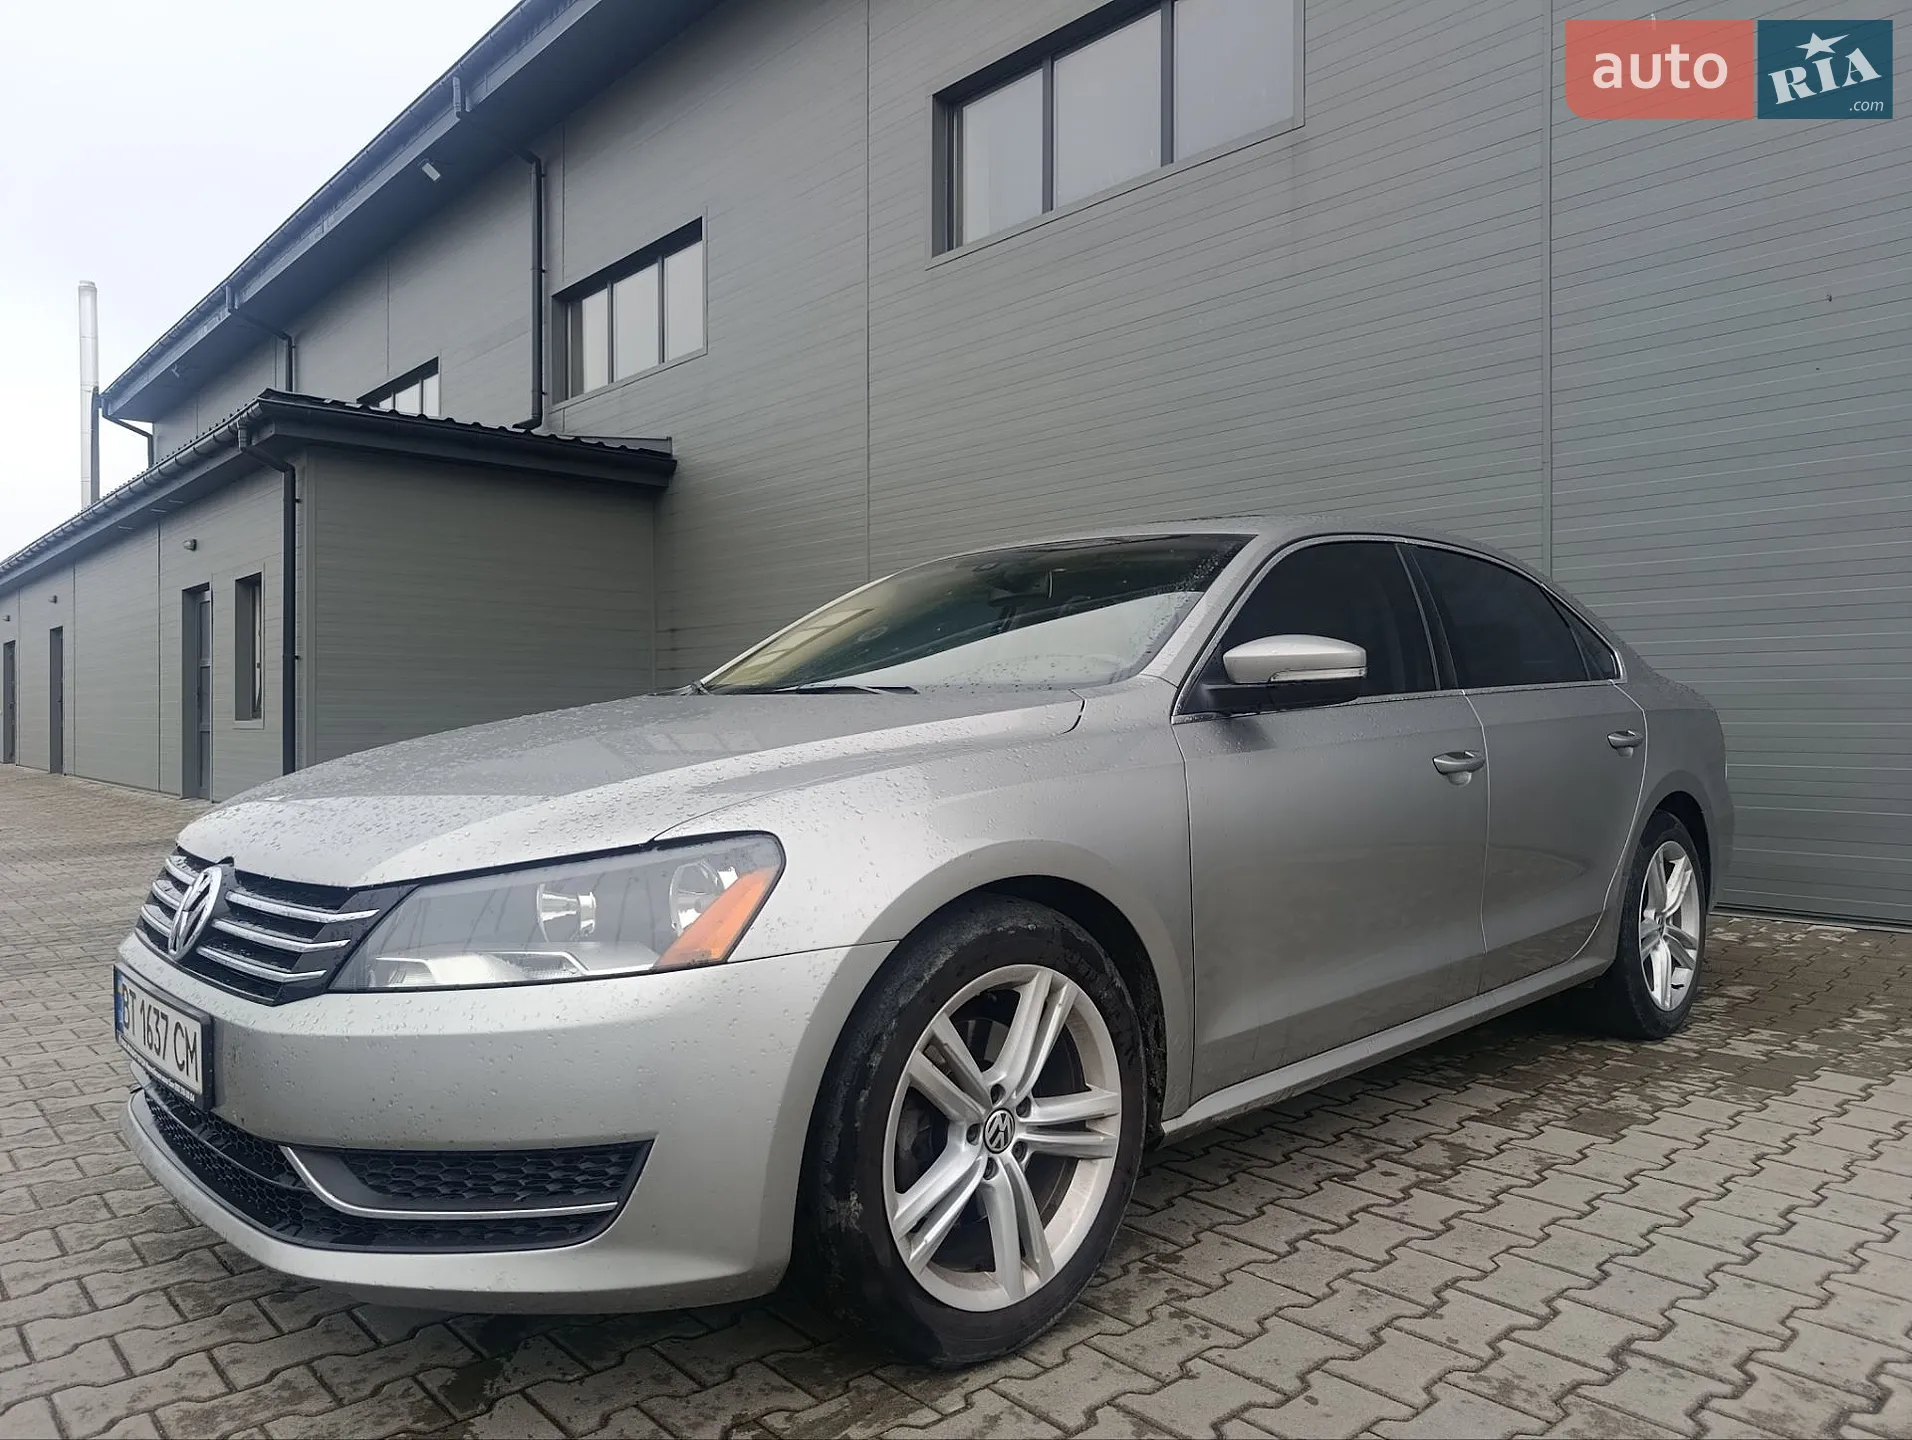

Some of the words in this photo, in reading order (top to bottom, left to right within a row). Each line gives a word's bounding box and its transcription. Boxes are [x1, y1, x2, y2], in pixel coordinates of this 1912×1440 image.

[122, 983, 136, 1037] BT
[140, 999, 168, 1060] 1637
[174, 1021, 198, 1082] CM
